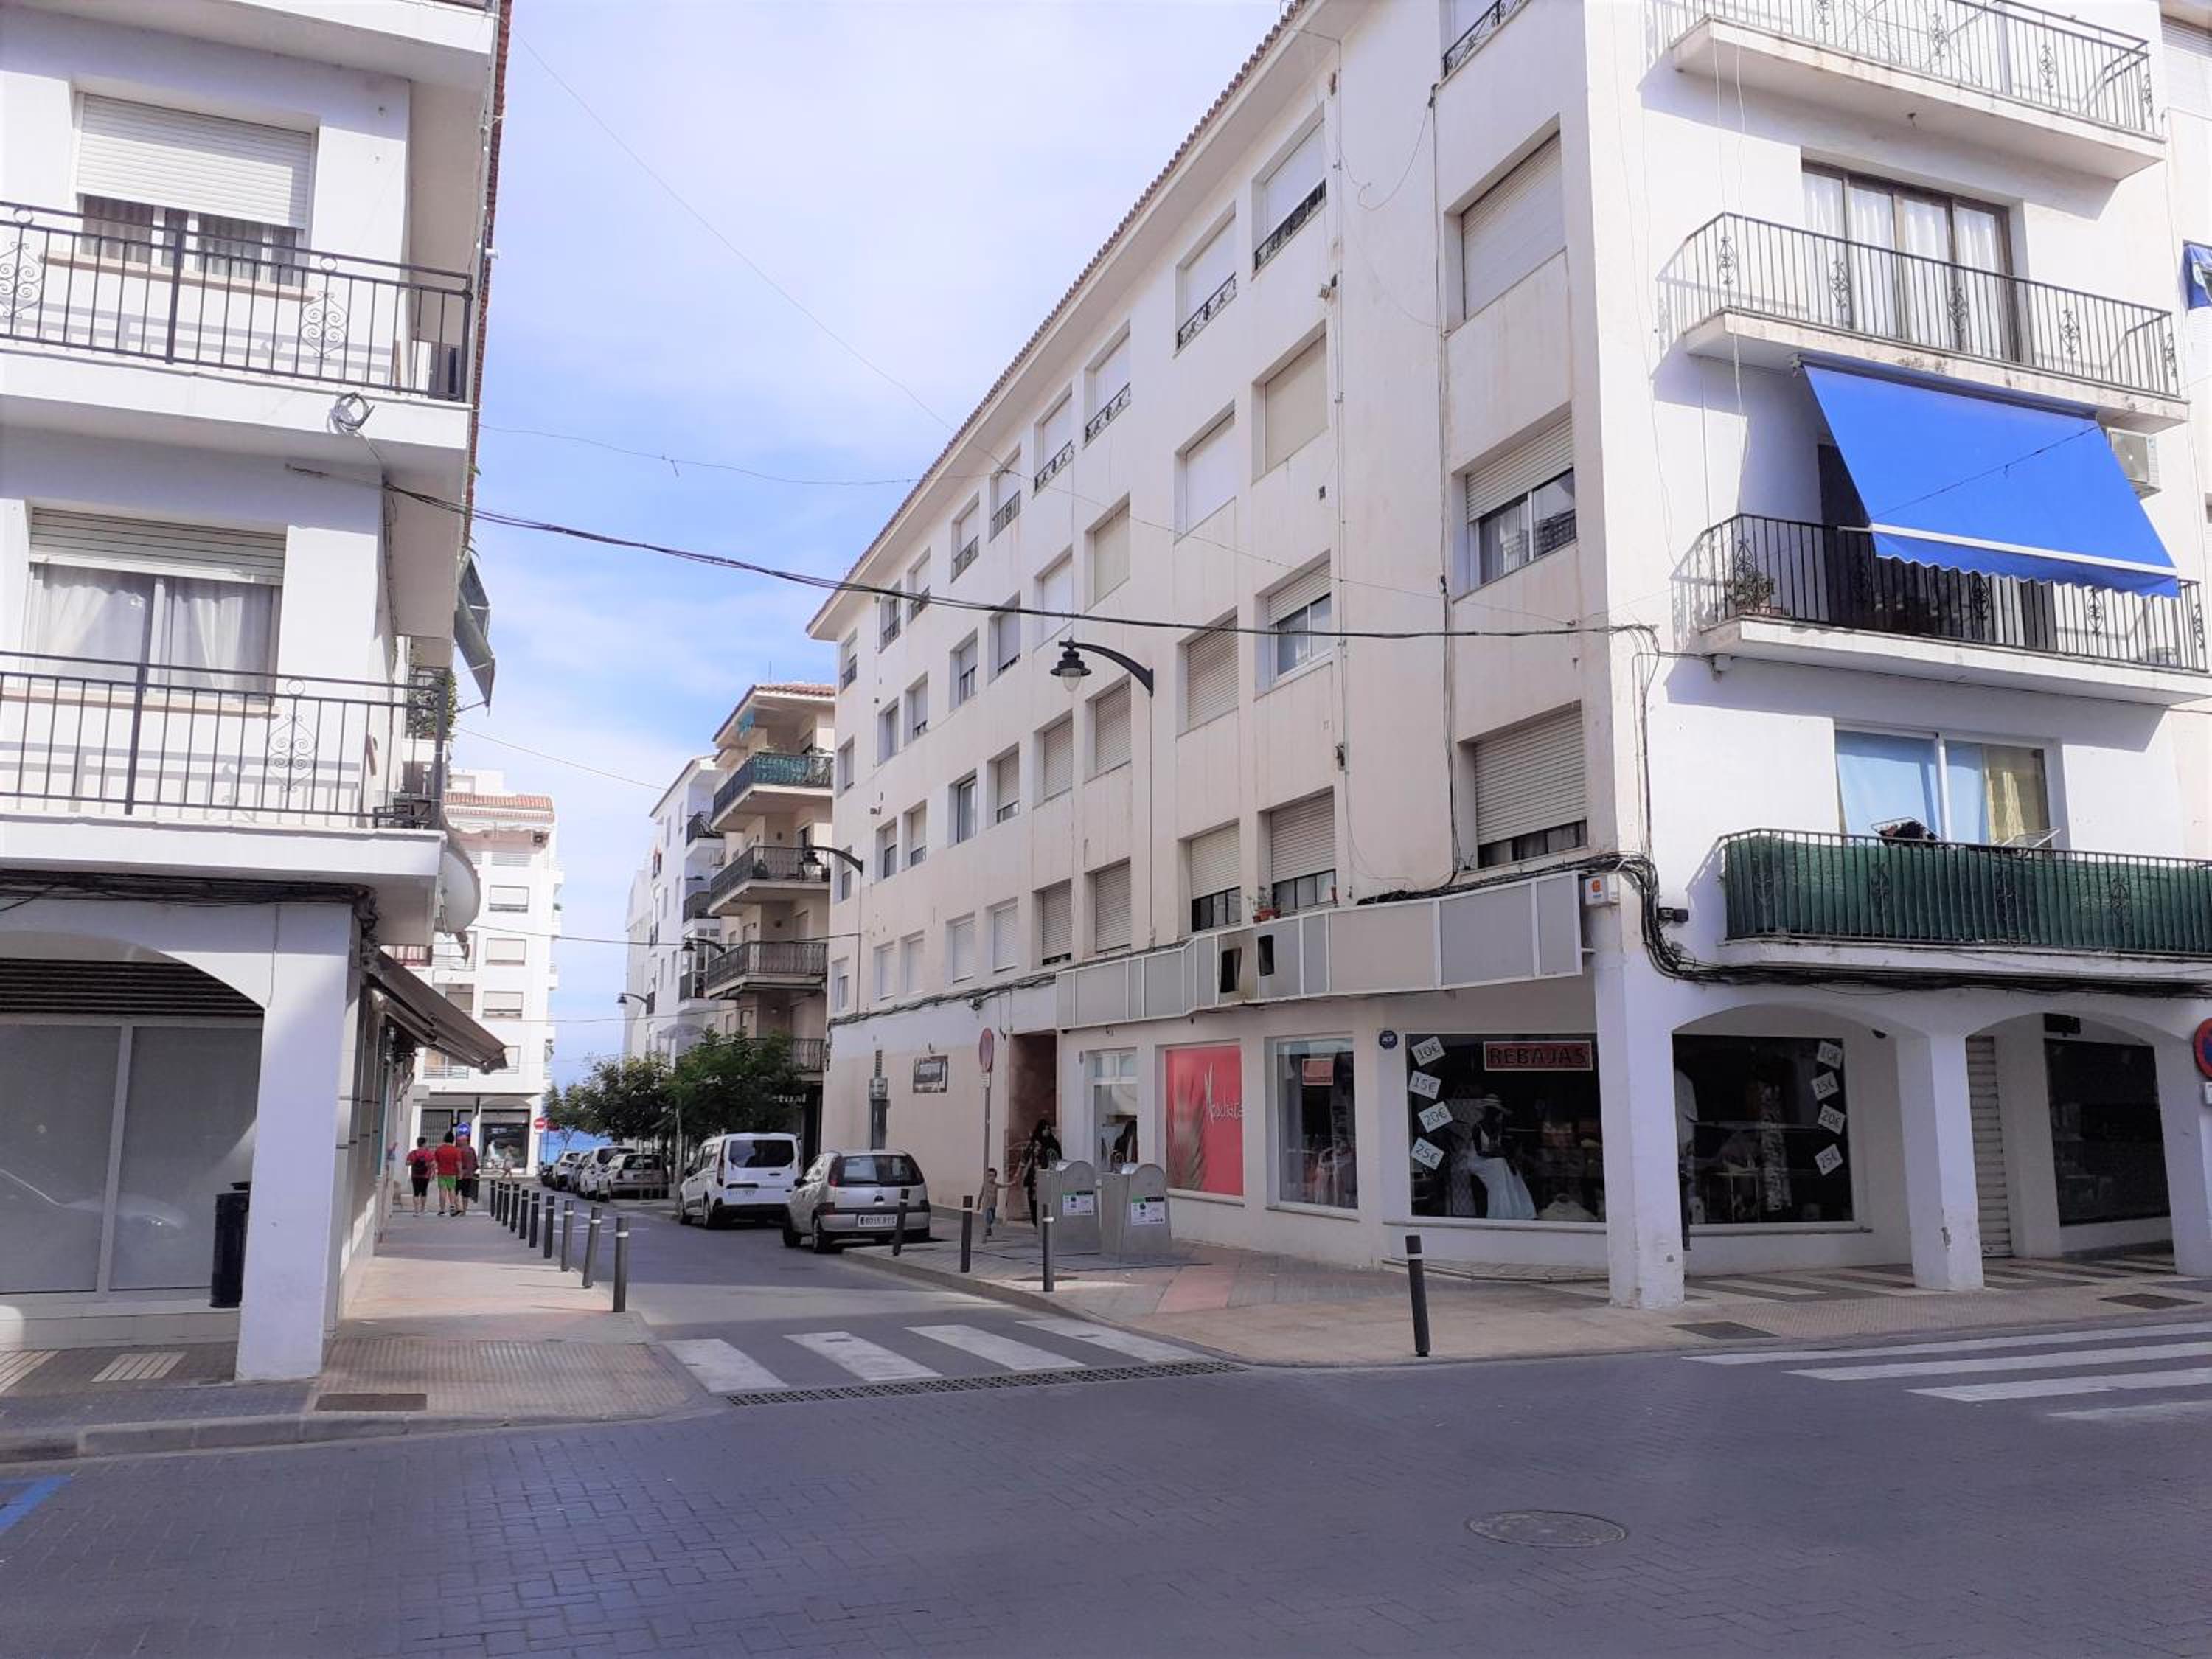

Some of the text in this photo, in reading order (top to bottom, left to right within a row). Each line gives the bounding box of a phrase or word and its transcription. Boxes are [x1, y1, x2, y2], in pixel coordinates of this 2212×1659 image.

[1416, 1043, 1440, 1060] 10€
[1489, 1047, 1589, 1064] REBAJAS
[1413, 1077, 1437, 1093] 15€
[1424, 1107, 1448, 1127] 20€
[1415, 1143, 1440, 1164] 25€
